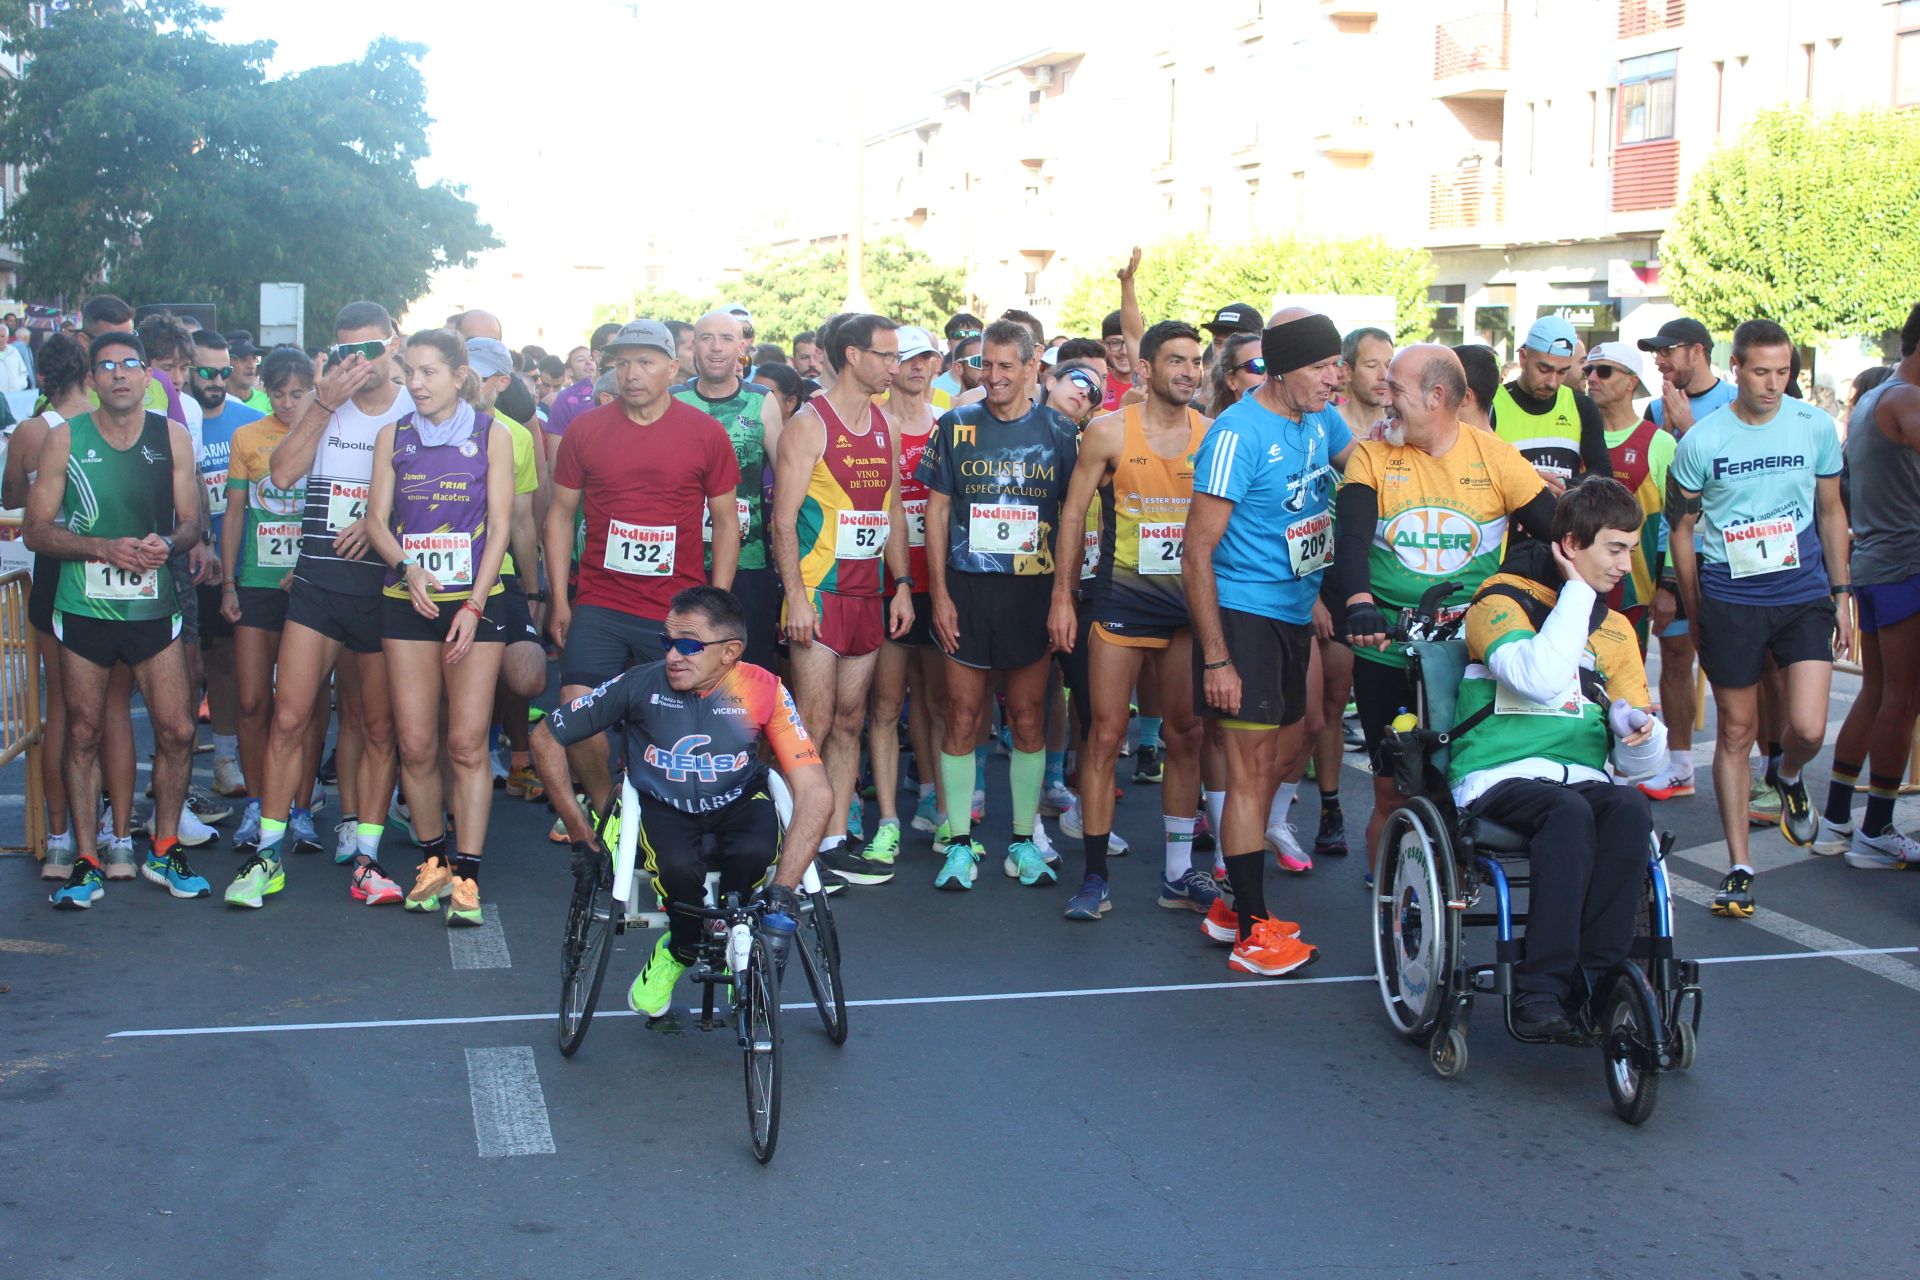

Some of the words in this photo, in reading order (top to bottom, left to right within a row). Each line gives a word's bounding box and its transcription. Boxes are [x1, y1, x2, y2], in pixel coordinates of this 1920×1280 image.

[856, 470, 879, 478] VINO
[961, 460, 1054, 481] COLISEUM
[1713, 455, 1804, 480] FERREIRA
[440, 481, 467, 491] PRIM
[850, 480, 862, 489] DE
[863, 480, 887, 488] TORO
[965, 484, 1047, 497] ESPECTACULOS
[433, 493, 470, 502] Macotera
[972, 506, 1037, 520] bedunia
[611, 522, 675, 543] bedunia
[856, 528, 876, 547] 52
[997, 522, 1010, 540] 8
[1725, 521, 1793, 543] bedunia
[404, 536, 469, 550] bedunia
[1300, 533, 1326, 561] 209
[1393, 531, 1473, 553] ALCER
[1756, 540, 1768, 559] 1
[417, 551, 454, 571] 101
[620, 542, 661, 562] 132
[712, 708, 748, 716] VICENTE
